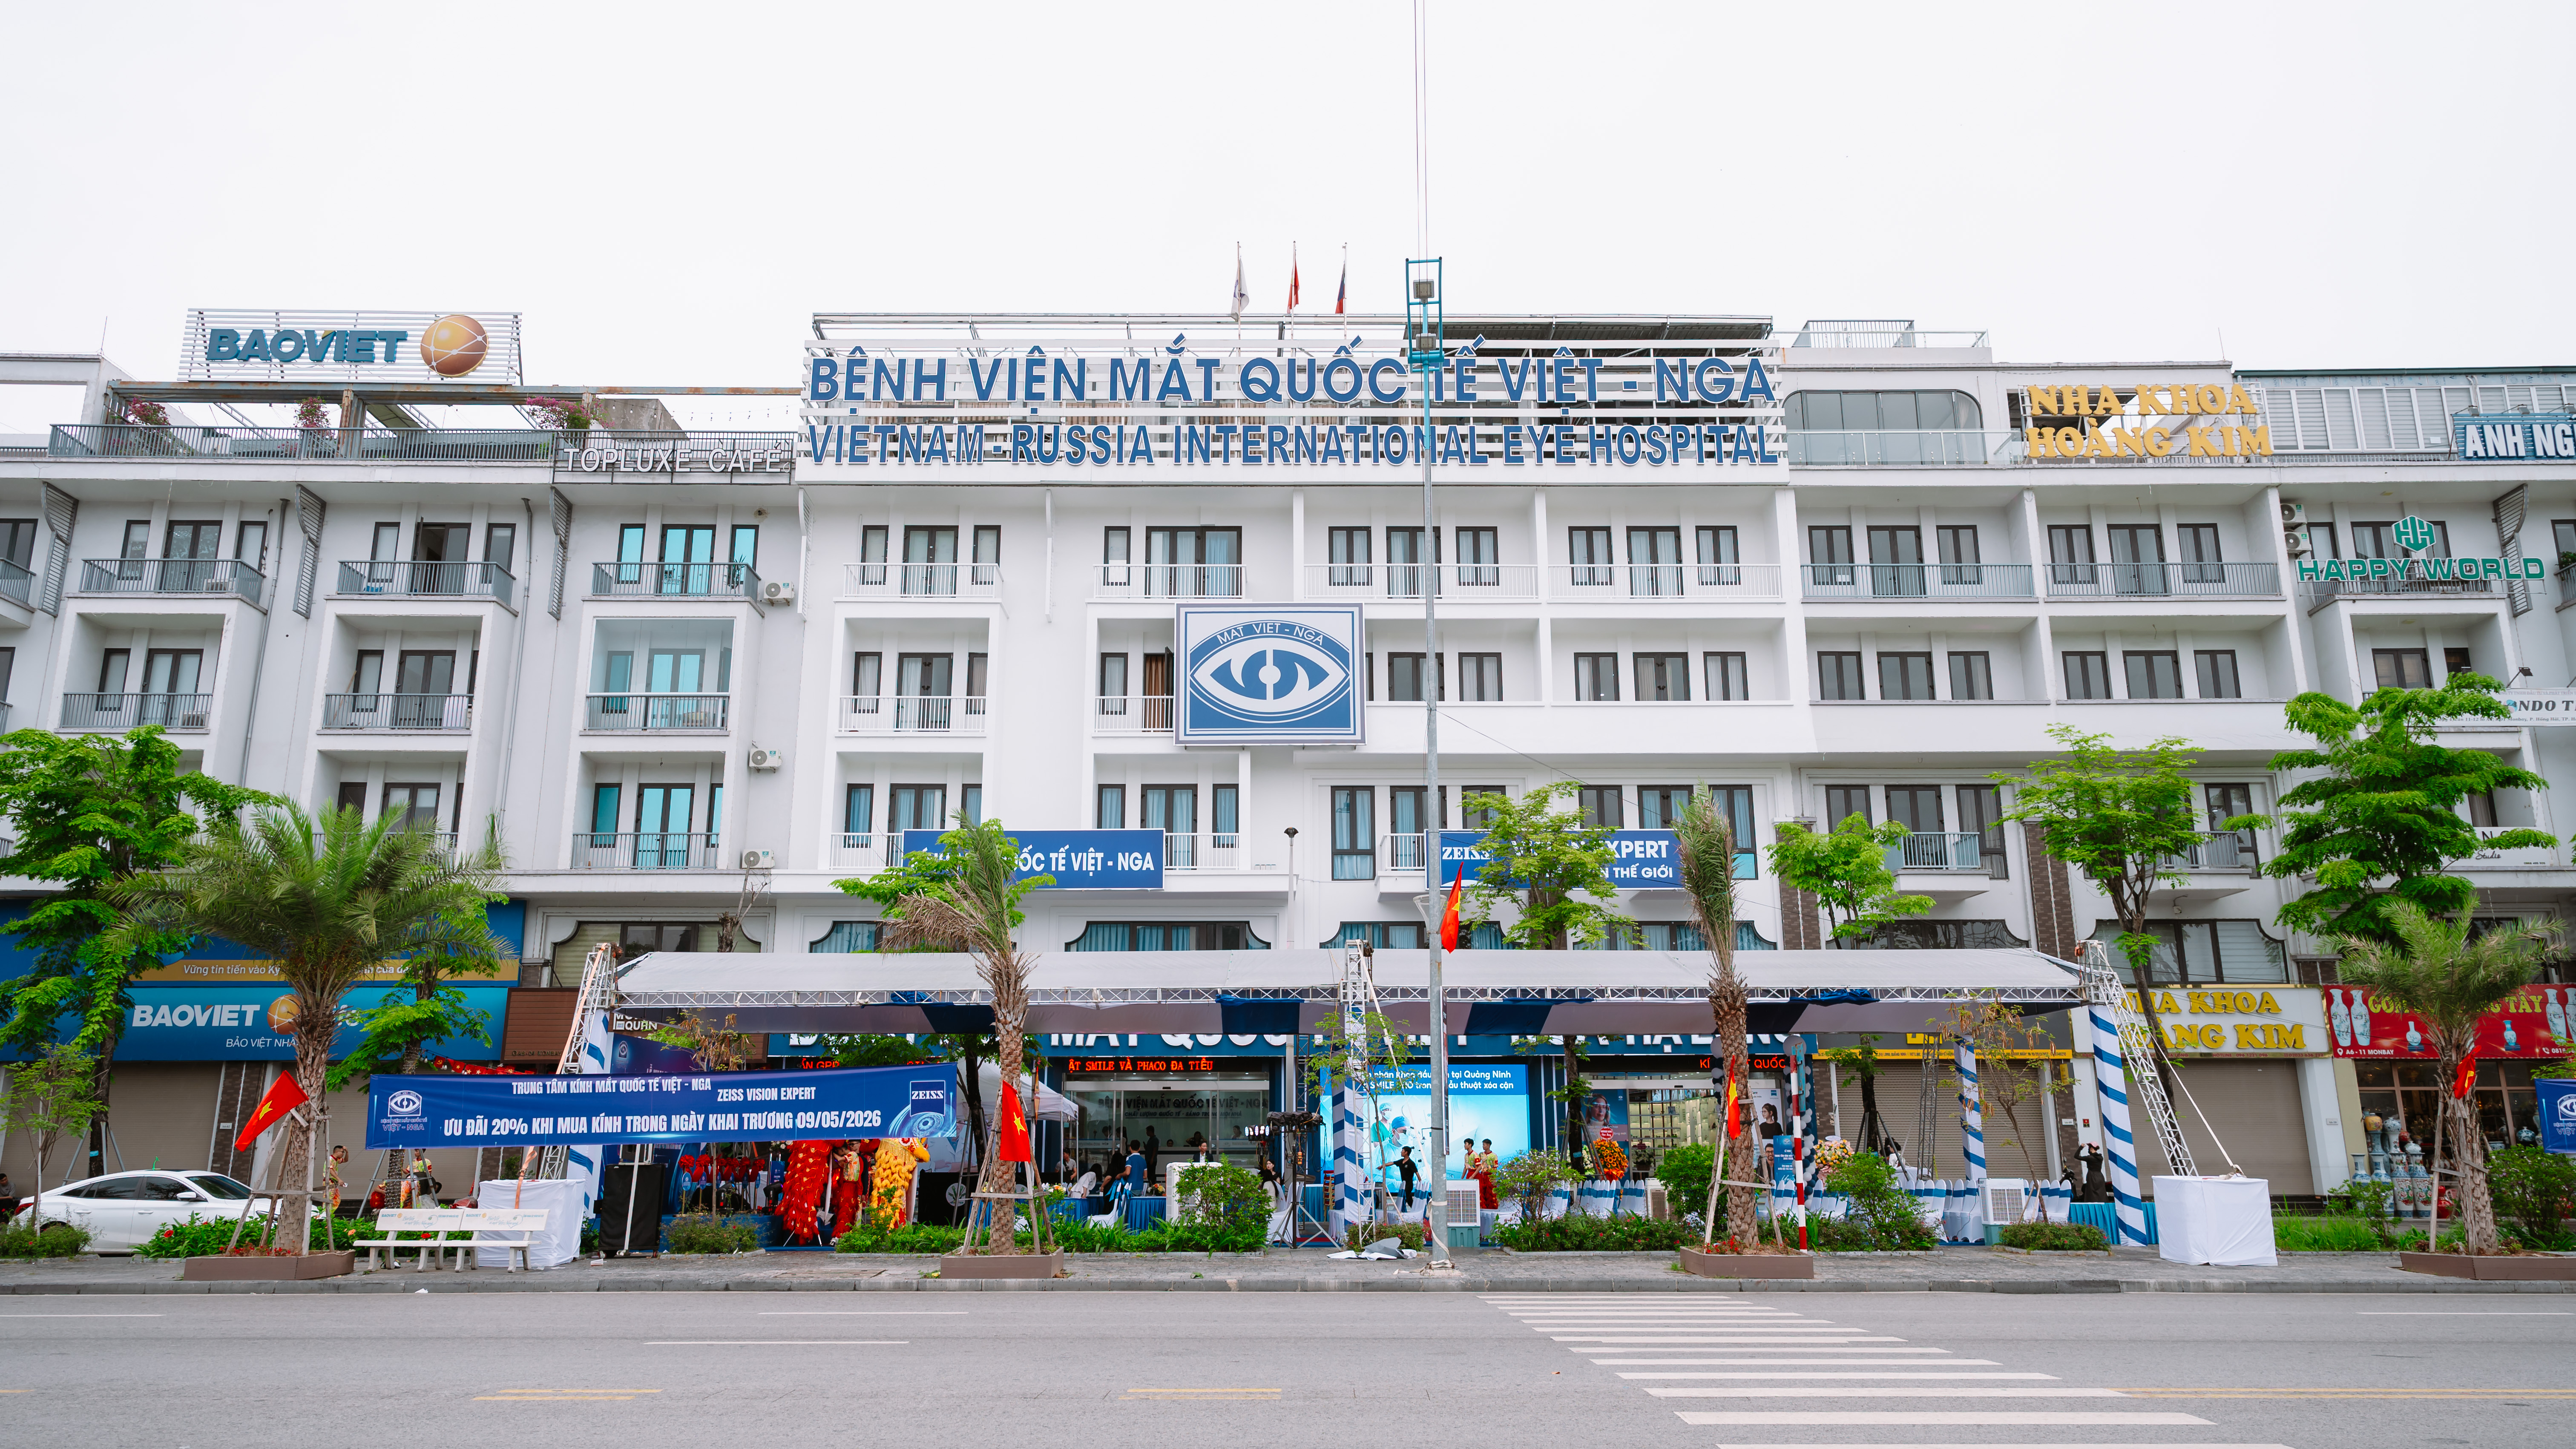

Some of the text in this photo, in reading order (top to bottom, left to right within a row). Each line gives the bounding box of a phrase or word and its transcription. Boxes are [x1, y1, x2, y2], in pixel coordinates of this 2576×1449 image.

[206, 328, 408, 362] BAOVIET
[809, 332, 1776, 417] BỆNH VIỆN MẮT QUỐC TẾ VIỆT - NGA
[2027, 383, 2258, 416] NHA KHOA
[1173, 424, 1490, 466] INTERNATIONAL
[1503, 424, 1576, 466] EYE
[1588, 424, 1779, 466] HOSPITAL
[2025, 417, 2274, 458] HOÀNG KIM
[2465, 414, 2576, 458] ANH NG
[563, 441, 782, 473] TOPLUXE CAFÉ
[2295, 558, 2544, 582] HAPPY WORLD
[1216, 626, 1244, 645] MAT
[1252, 623, 1280, 634] VIET
[1294, 627, 1324, 646] NGA
[1608, 840, 1669, 859] XPERT
[1049, 844, 1070, 871] TẾ
[1071, 847, 1104, 877] VIỆT
[1118, 852, 1155, 871] NGA
[1613, 862, 1640, 878] THẾ
[1641, 863, 1673, 878] GIỚI
[184, 965, 209, 976] Vững
[211, 965, 224, 974] tin
[227, 964, 246, 974] tiến
[248, 965, 266, 974] vào
[2188, 992, 2282, 1013] KHOA
[132, 1005, 260, 1027] BAOVIET
[226, 1036, 298, 1048] BẢO VIỆT NHÂ
[2234, 1024, 2306, 1049] KIM
[1086, 1061, 1115, 1071] SMILE
[1119, 1057, 1132, 1070] VÀ
[1137, 1061, 1166, 1071] PHACO
[1170, 1061, 1184, 1071] ĐA
[1451, 1070, 1462, 1079] tại
[1464, 1070, 1490, 1080] Quảng
[1492, 1070, 1511, 1078] Ninh
[1461, 1081, 1481, 1090] thuật
[1500, 1082, 1513, 1090] cận
[512, 1081, 543, 1095] TRUNG
[546, 1078, 567, 1094] TÂM
[570, 1078, 592, 1094] KÍNH
[595, 1077, 617, 1093] MẮT
[619, 1077, 645, 1093] QUỐC
[648, 1077, 661, 1092] TẾ
[661, 1077, 682, 1094] VIỆT
[692, 1078, 711, 1091] NGA
[718, 1087, 816, 1102] ZEISS VISION EXPERT
[912, 1090, 943, 1099] ZEISS
[1126, 1095, 1148, 1110] VIỆN
[1150, 1093, 1171, 1108] MẮT
[1173, 1093, 1204, 1108] QUỐC
[1219, 1095, 1239, 1110] VIỆT
[382, 1123, 401, 1132] VIỆT
[444, 1110, 881, 1136] ƯU ĐÃI 20% KHI MUA KÍNH TRONG NGÀY KHAI TRƯƠNG 09/05/2026
[2556, 1127, 2576, 1136] VIỆT
